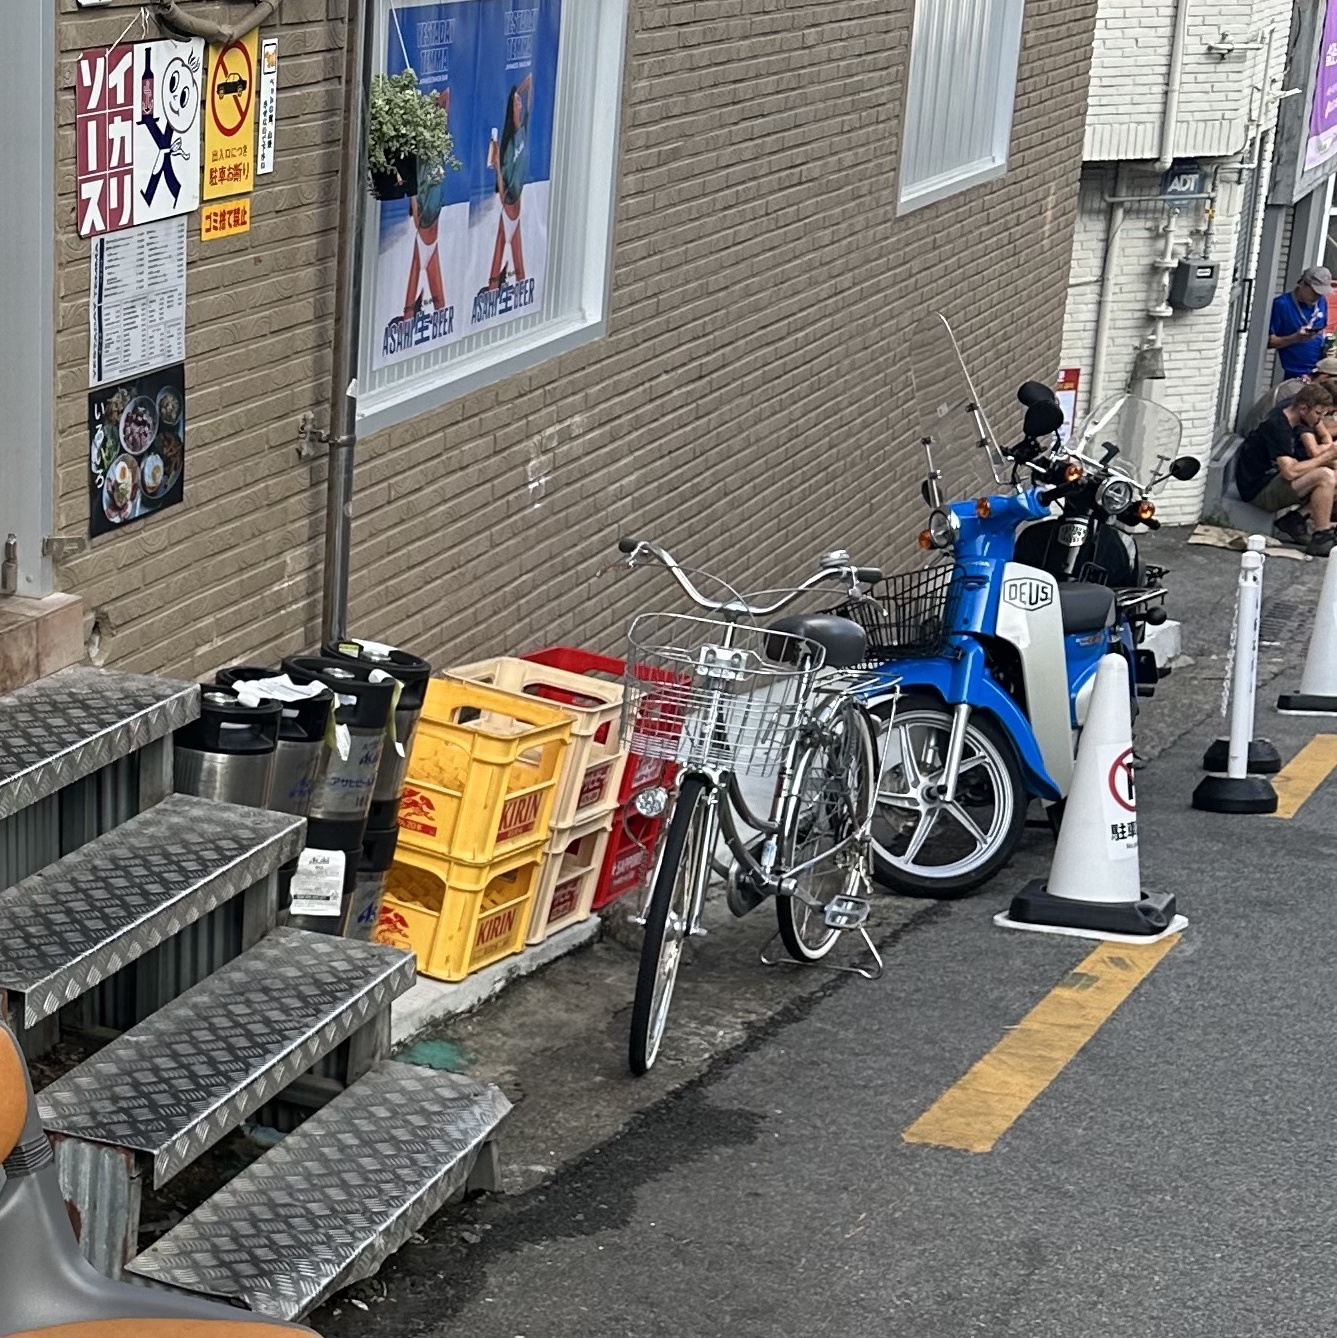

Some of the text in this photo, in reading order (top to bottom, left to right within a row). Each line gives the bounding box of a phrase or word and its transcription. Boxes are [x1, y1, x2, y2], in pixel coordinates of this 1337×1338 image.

[80, 56, 105, 236] ソース
[109, 51, 133, 226] イカリ
[209, 162, 249, 187] 駐車お断り
[1167, 174, 1199, 192] ADT
[205, 205, 247, 233] ゴミ捨て禁止
[1008, 577, 1049, 605] DEUS
[499, 792, 544, 832] KIRIN
[476, 908, 516, 946] KIRIN
